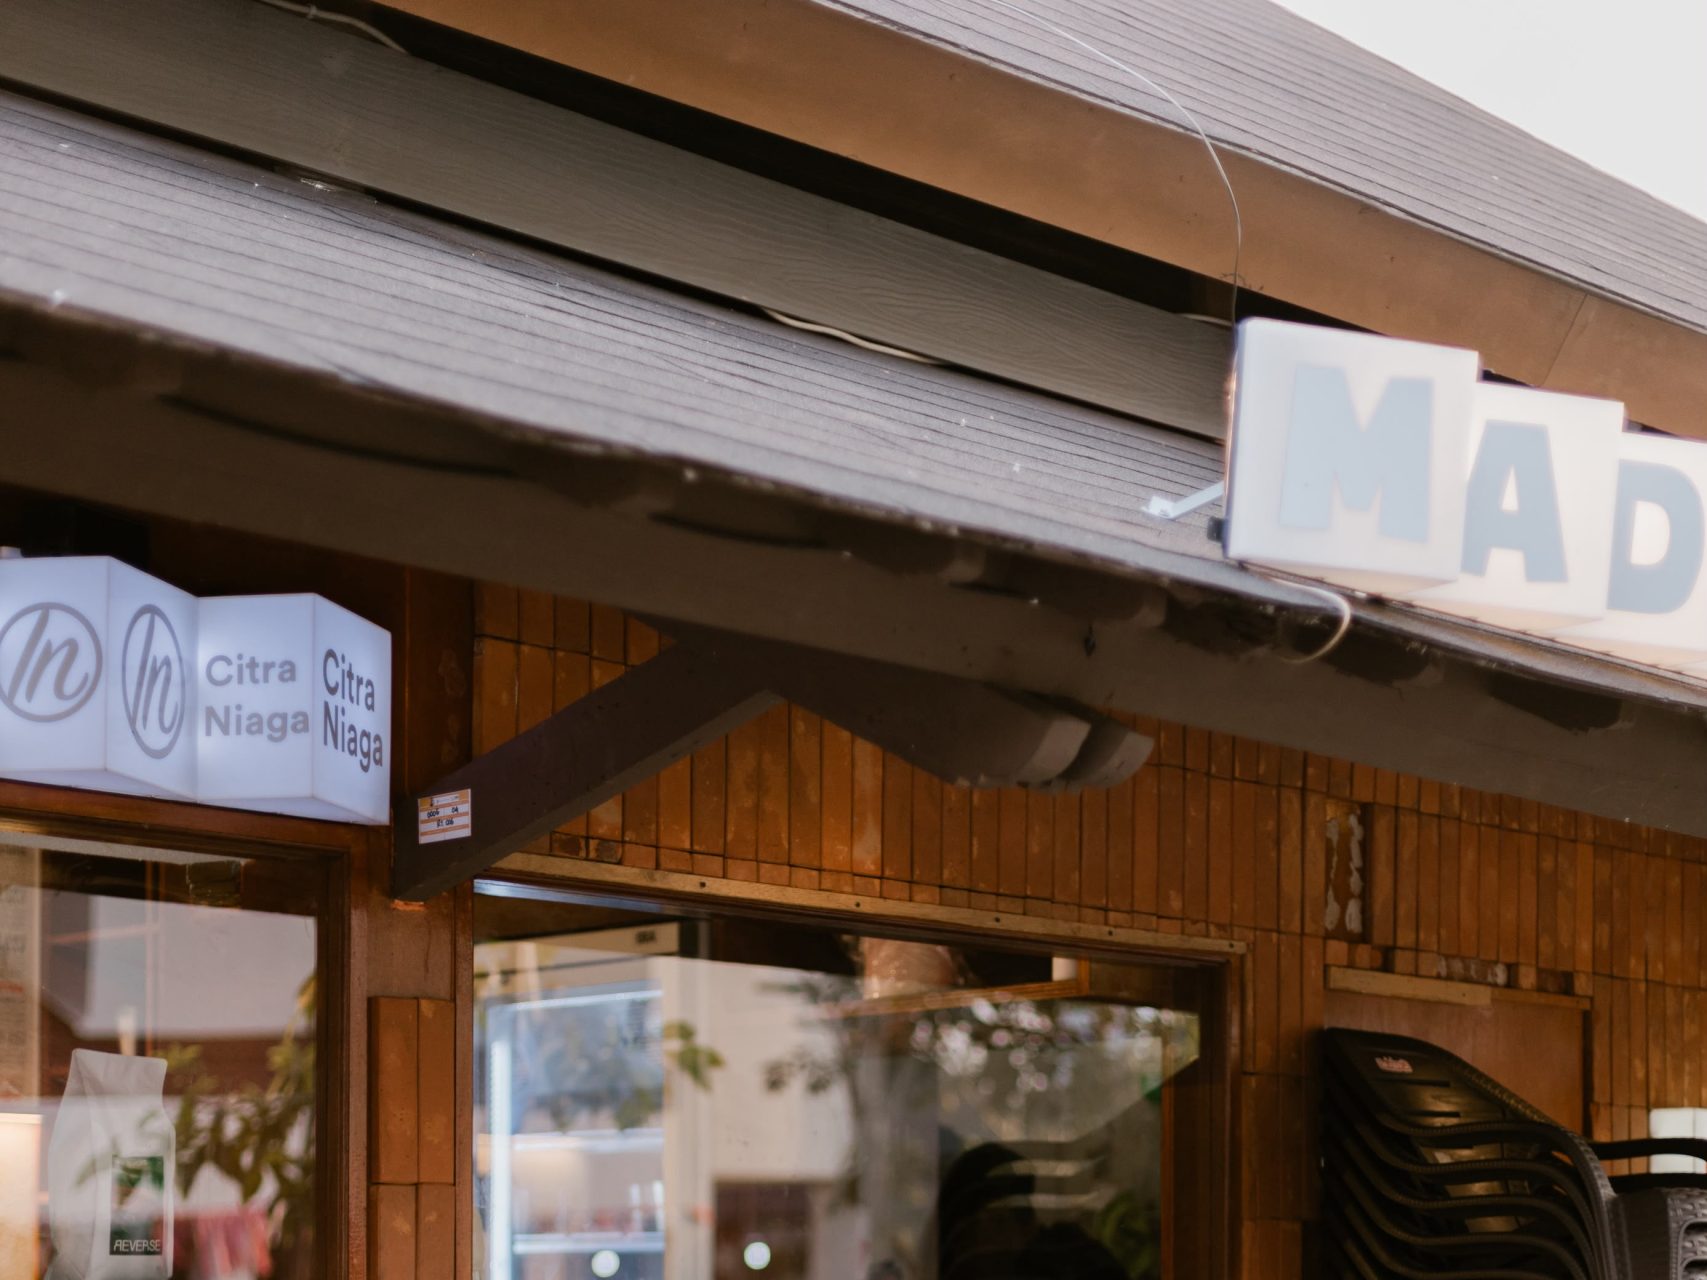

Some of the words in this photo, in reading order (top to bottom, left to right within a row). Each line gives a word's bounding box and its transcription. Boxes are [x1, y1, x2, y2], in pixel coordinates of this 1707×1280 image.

[1279, 362, 1706, 616] MAD
[205, 653, 297, 687] Citra
[322, 648, 375, 712] Citra
[205, 704, 310, 743] Niaga
[322, 701, 383, 773] Niaga
[113, 1239, 161, 1252] REVERSE
